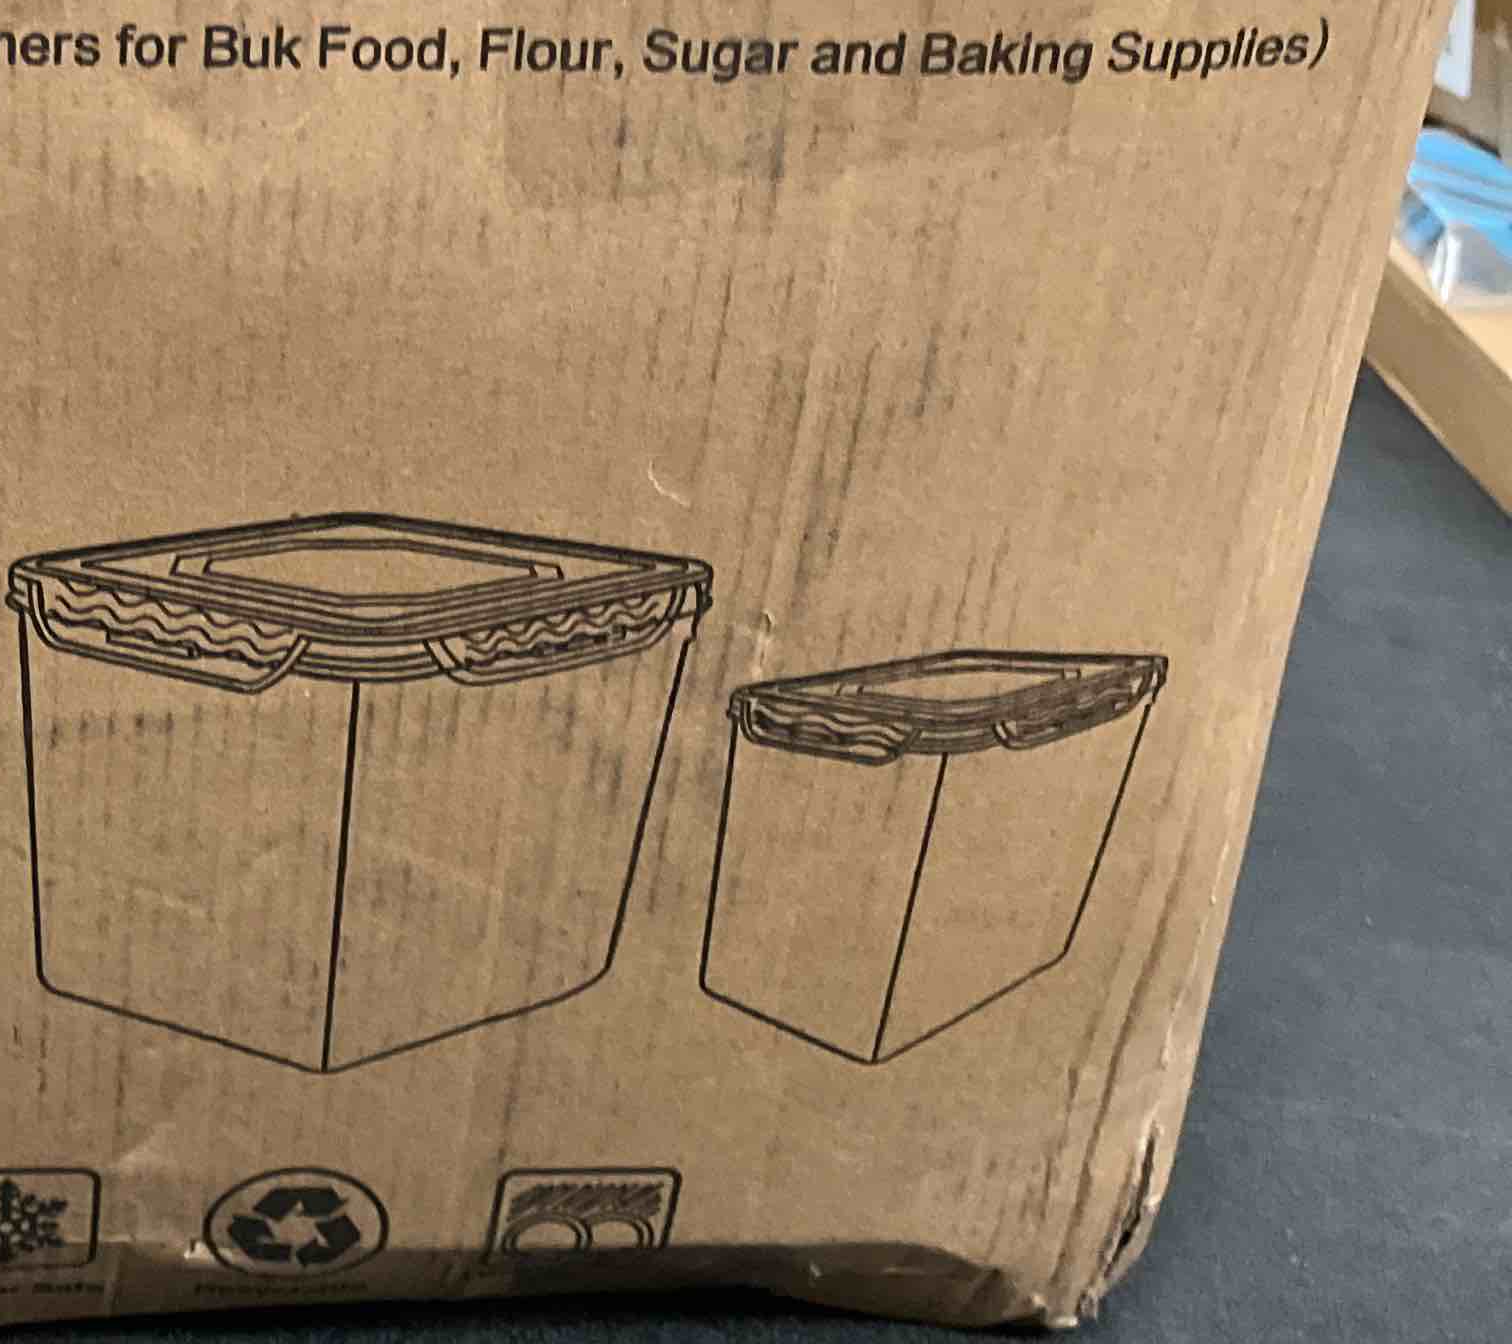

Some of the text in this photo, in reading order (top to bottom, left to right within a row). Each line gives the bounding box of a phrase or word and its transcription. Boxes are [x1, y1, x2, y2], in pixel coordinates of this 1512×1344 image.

[115, 23, 188, 69] for
[203, 24, 302, 70] Buk
[318, 25, 460, 79] Food,
[479, 27, 624, 80] Flour,
[643, 28, 797, 85] Sugar
[810, 31, 907, 76] and
[919, 30, 1095, 85] Baking
[1106, 17, 1330, 81] Supplies)
